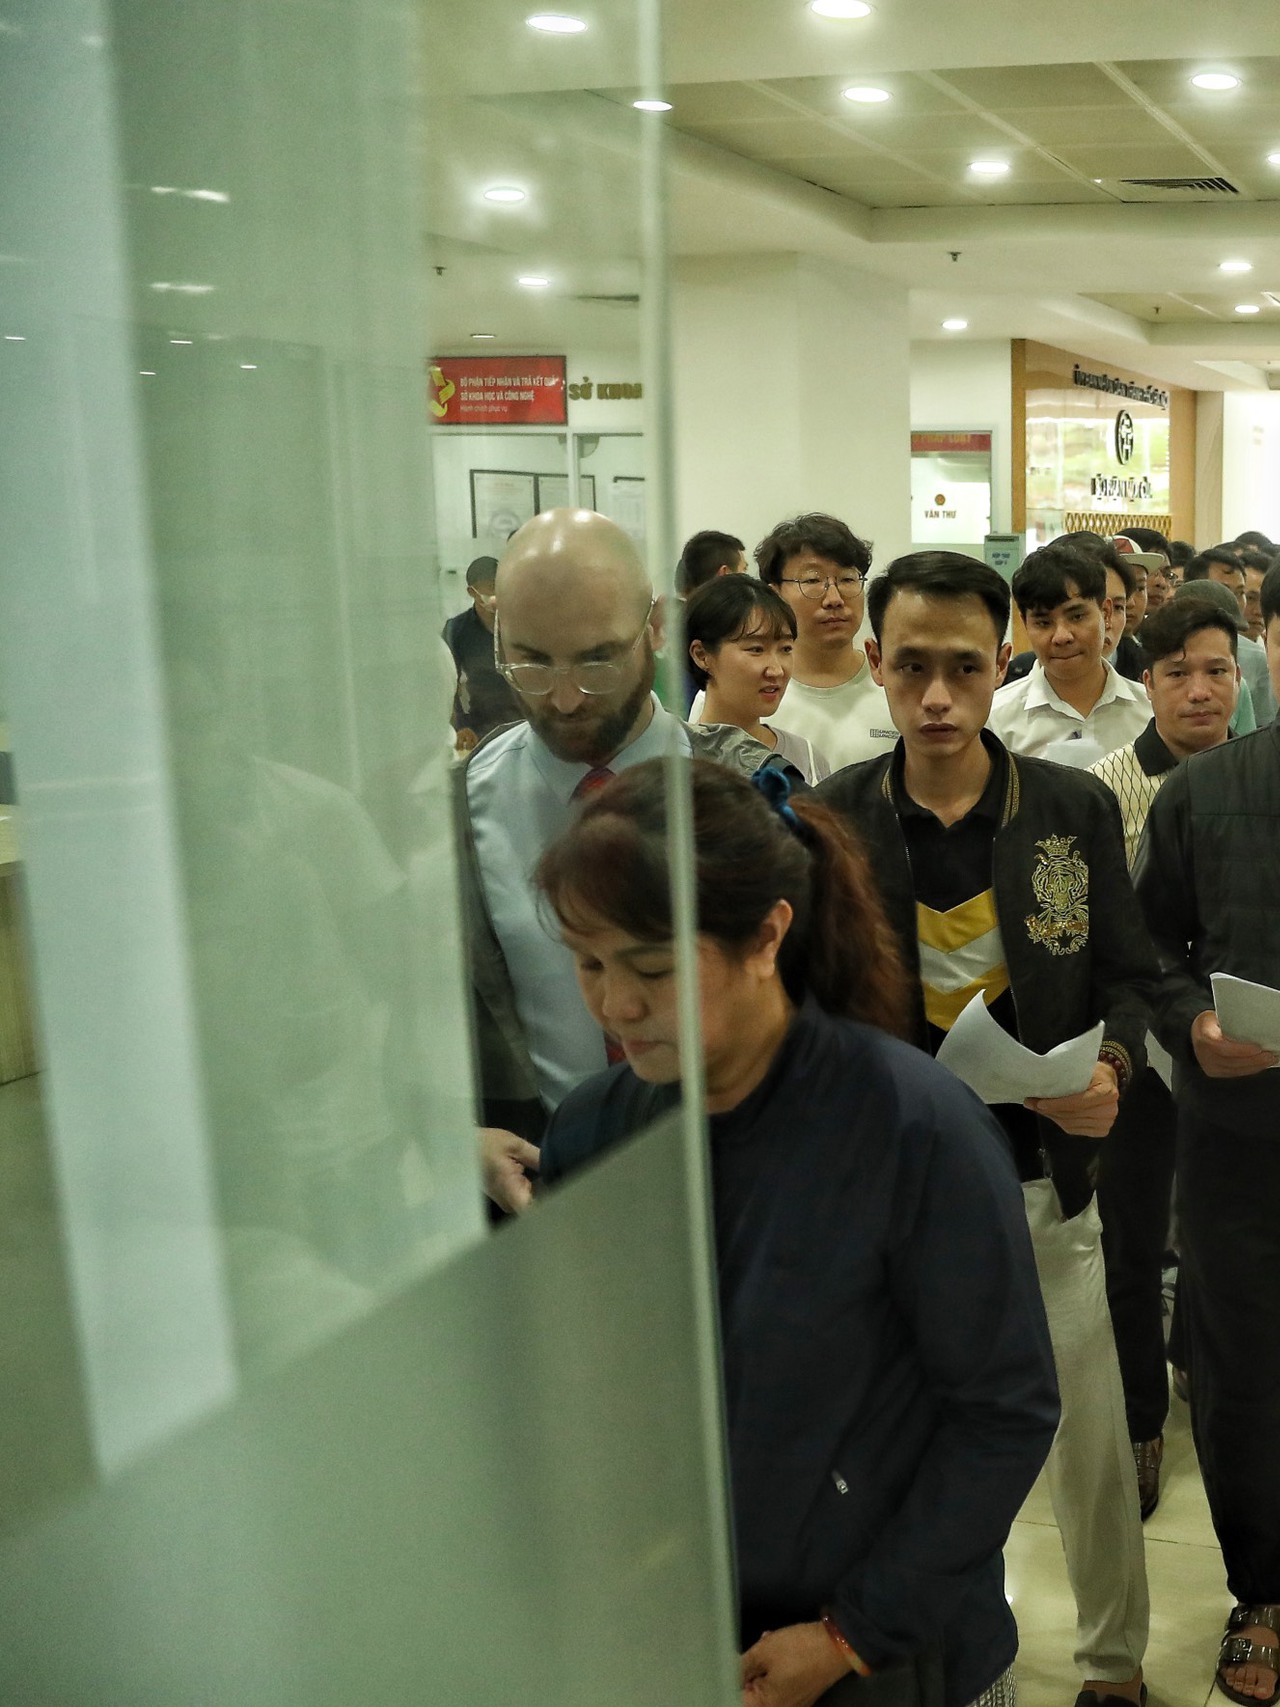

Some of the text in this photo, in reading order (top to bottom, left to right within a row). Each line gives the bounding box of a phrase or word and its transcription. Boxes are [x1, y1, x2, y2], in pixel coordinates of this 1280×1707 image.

[568, 376, 593, 400] SỞ
[469, 391, 483, 401] KHOA
[925, 509, 956, 519] VĂN THƯ
